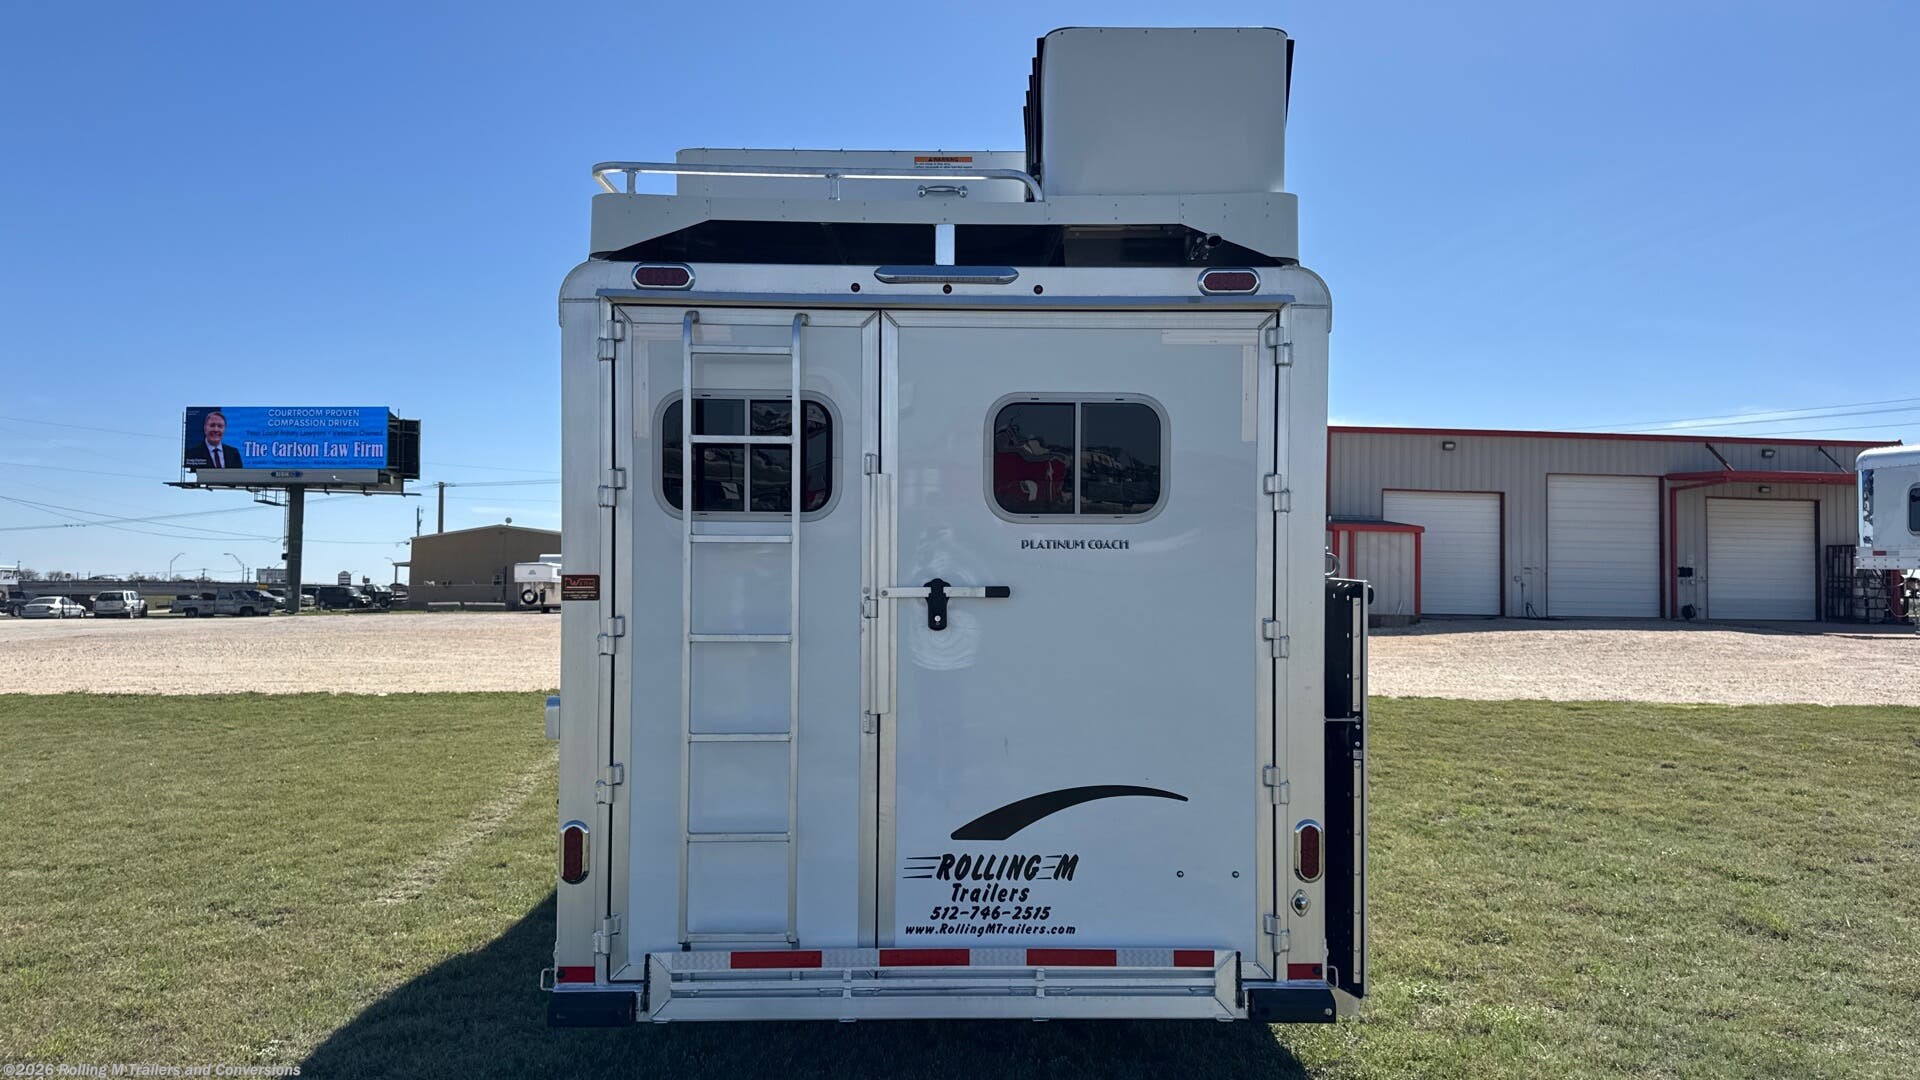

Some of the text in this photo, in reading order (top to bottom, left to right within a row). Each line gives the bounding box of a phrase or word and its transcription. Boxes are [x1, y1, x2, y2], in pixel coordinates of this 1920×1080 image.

[268, 409, 360, 417] COURTROOM PROVEN
[267, 419, 360, 427] COMPASSION DRIVEN
[244, 441, 384, 457] The Carlson Law Firm
[1021, 539, 1129, 550] PLATINUM COACH
[936, 853, 1079, 881] ROLLING M
[951, 882, 1030, 902] Trailers
[930, 905, 1051, 920] 512-746-2515
[905, 922, 1076, 937] www.RollingMTrailers.com
